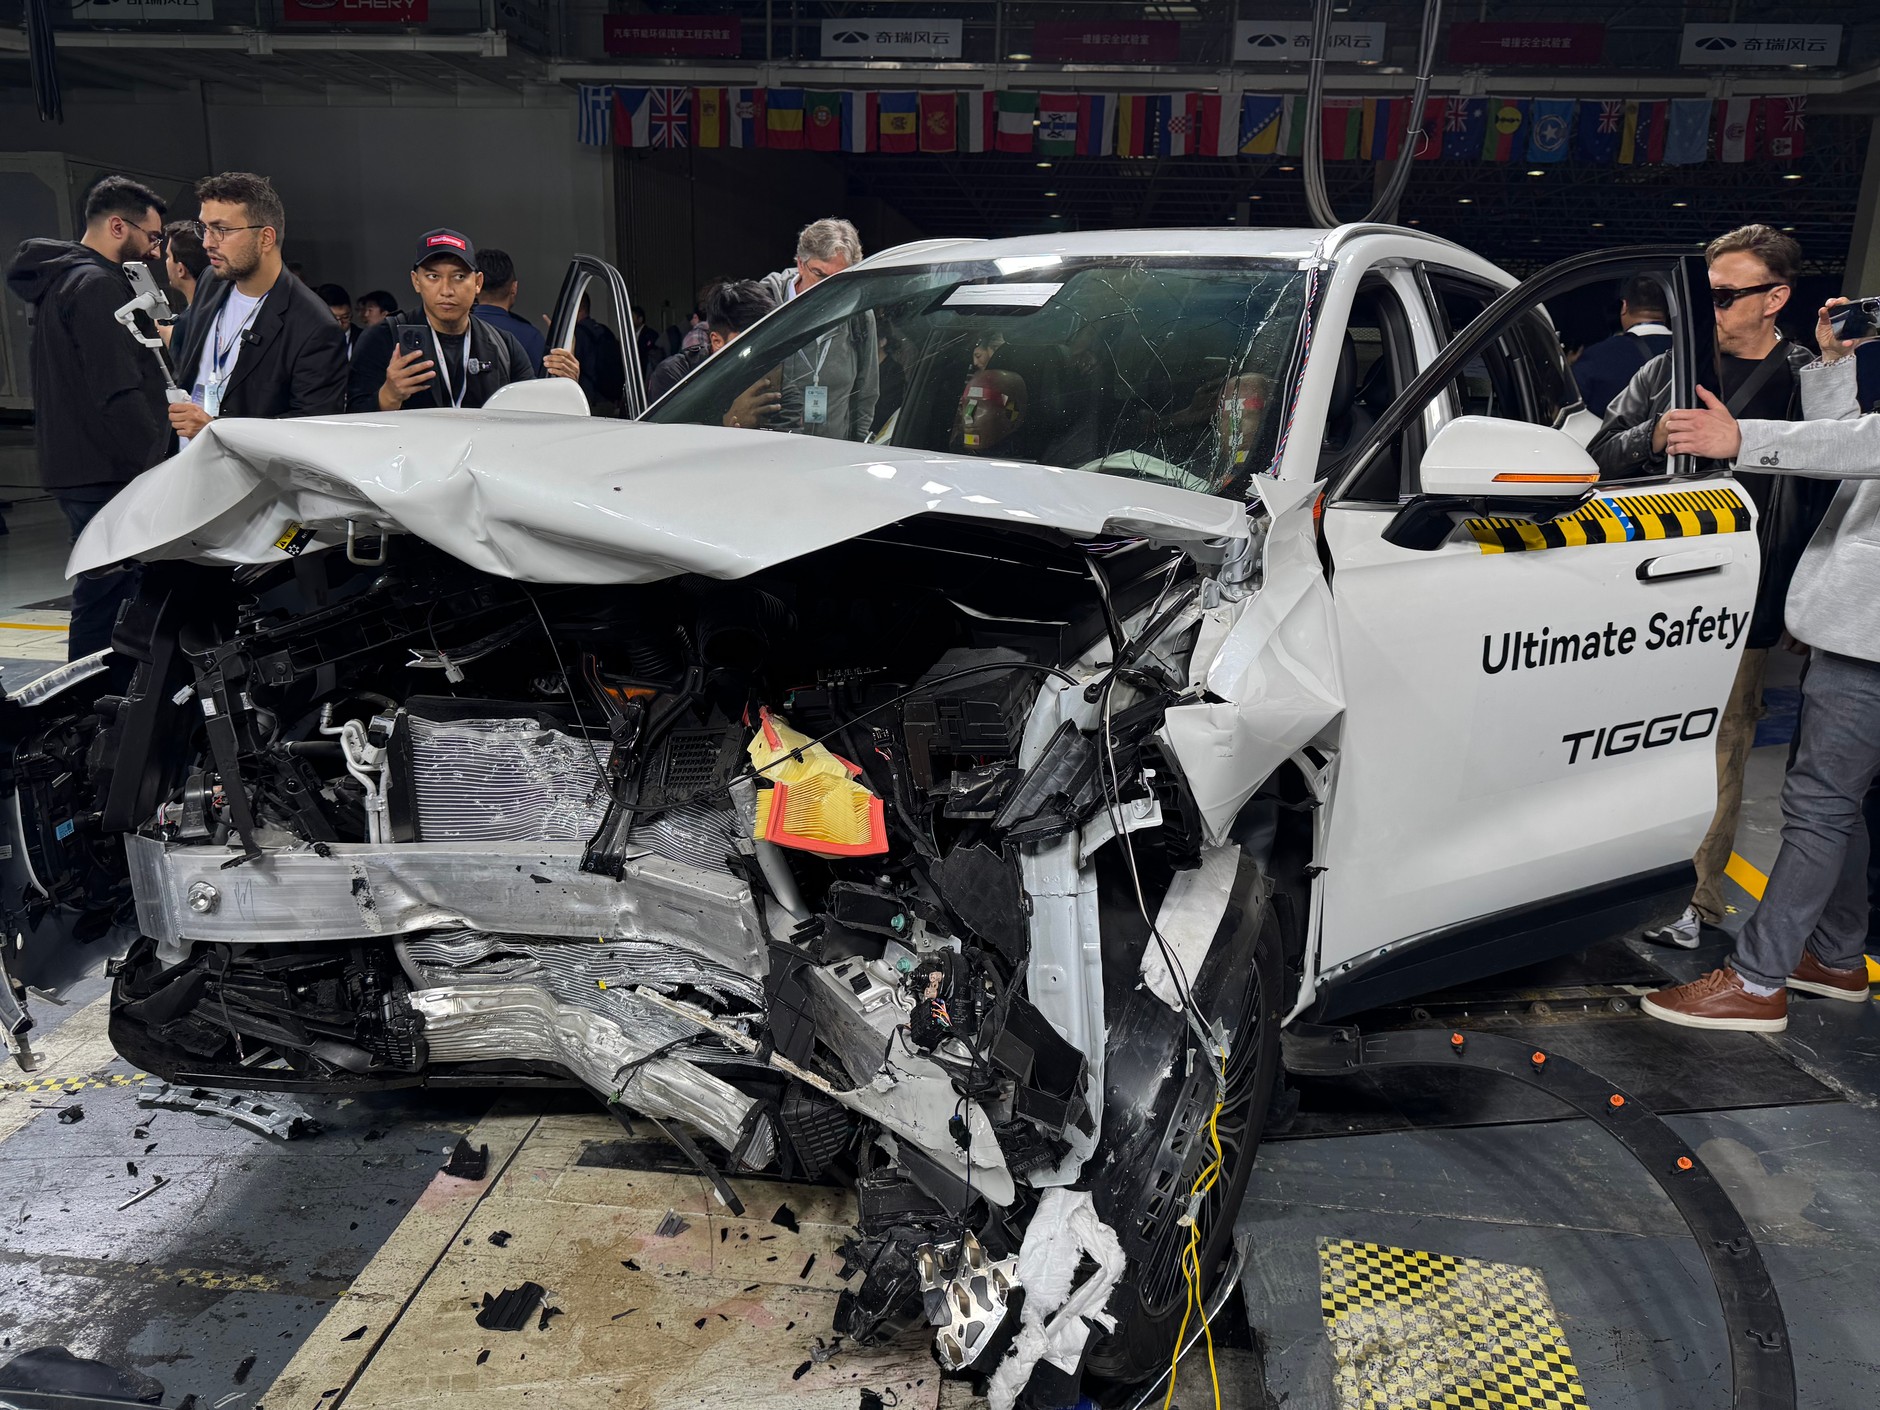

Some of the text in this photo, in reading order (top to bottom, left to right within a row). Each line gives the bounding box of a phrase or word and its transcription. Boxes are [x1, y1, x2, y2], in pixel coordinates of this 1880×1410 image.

[874, 31, 950, 45] 奇瑞风云
[1292, 34, 1372, 48] 奇风云
[1743, 38, 1827, 52] 奇瑞风云
[1482, 606, 1750, 674] Ultimate Safety
[1561, 706, 1719, 765] TIGGO
